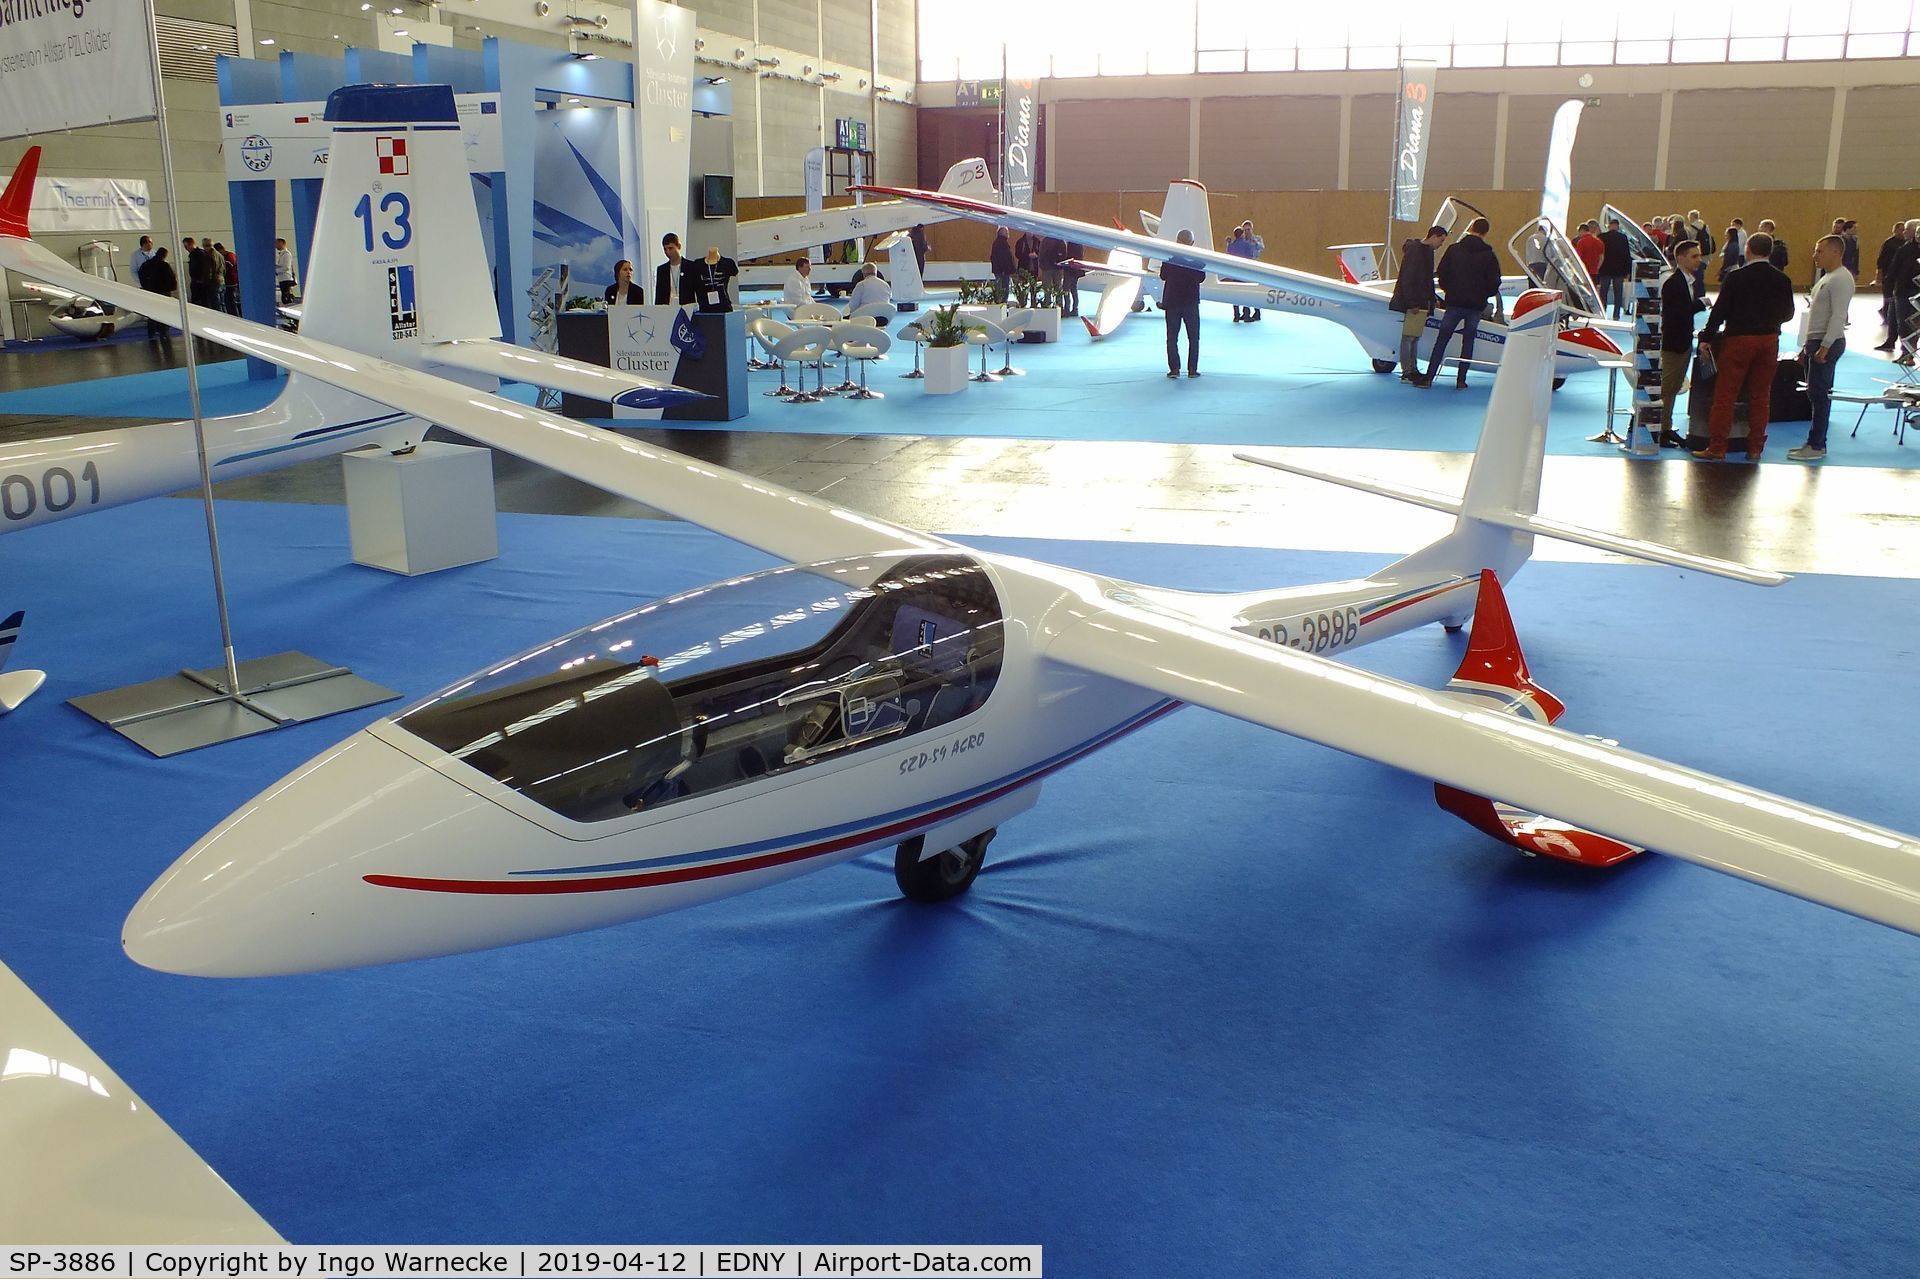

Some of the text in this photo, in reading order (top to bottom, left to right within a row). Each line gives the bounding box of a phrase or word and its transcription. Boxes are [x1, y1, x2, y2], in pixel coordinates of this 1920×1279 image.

[67, 34, 85, 59] PZL
[85, 26, 112, 54] Glider
[957, 81, 979, 97] A1
[1405, 82, 1428, 104] 3
[1008, 95, 1032, 178] Diana
[1400, 105, 1424, 181] Diana
[354, 192, 413, 253] 13
[617, 356, 670, 371] Cluster
[899, 745, 947, 776] SZD-59
